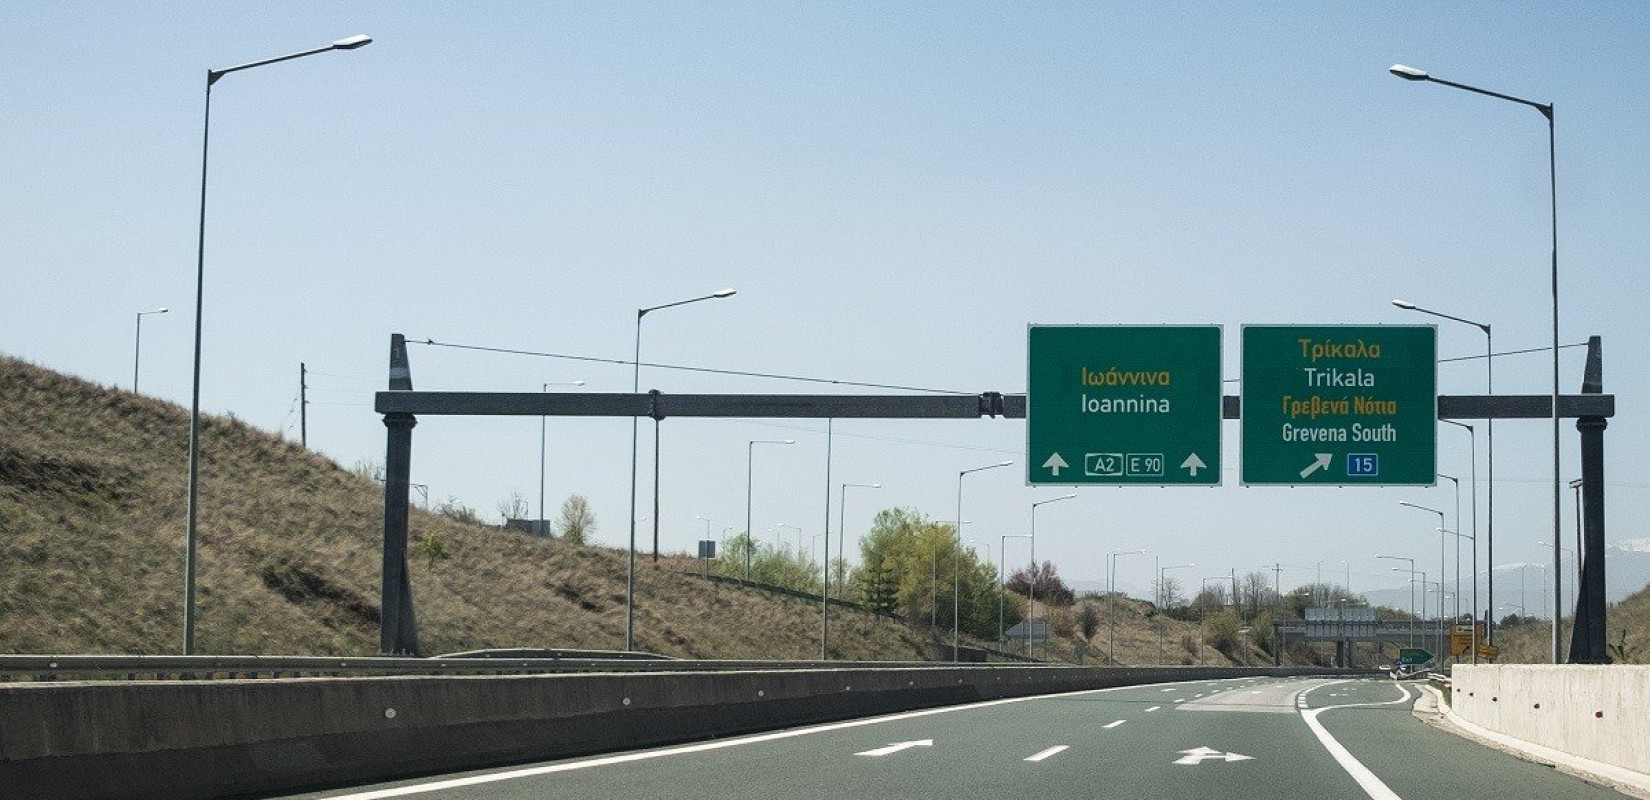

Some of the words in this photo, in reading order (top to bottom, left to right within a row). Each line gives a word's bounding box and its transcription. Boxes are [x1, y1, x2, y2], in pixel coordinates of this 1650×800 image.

[1298, 339, 1380, 362] Τρίκαλα
[1081, 366, 1170, 386] Ιωάννινα
[1304, 368, 1375, 387] Trikala
[1081, 393, 1170, 413] Ioannina
[1282, 396, 1349, 419] Γρεβενά
[1353, 396, 1397, 415] Νότια
[1282, 422, 1347, 442] Grevena
[1352, 422, 1397, 442] South
[1094, 457, 1115, 472] A2
[1131, 457, 1140, 472] E
[1144, 457, 1161, 472] 90
[1355, 457, 1373, 472] 15
